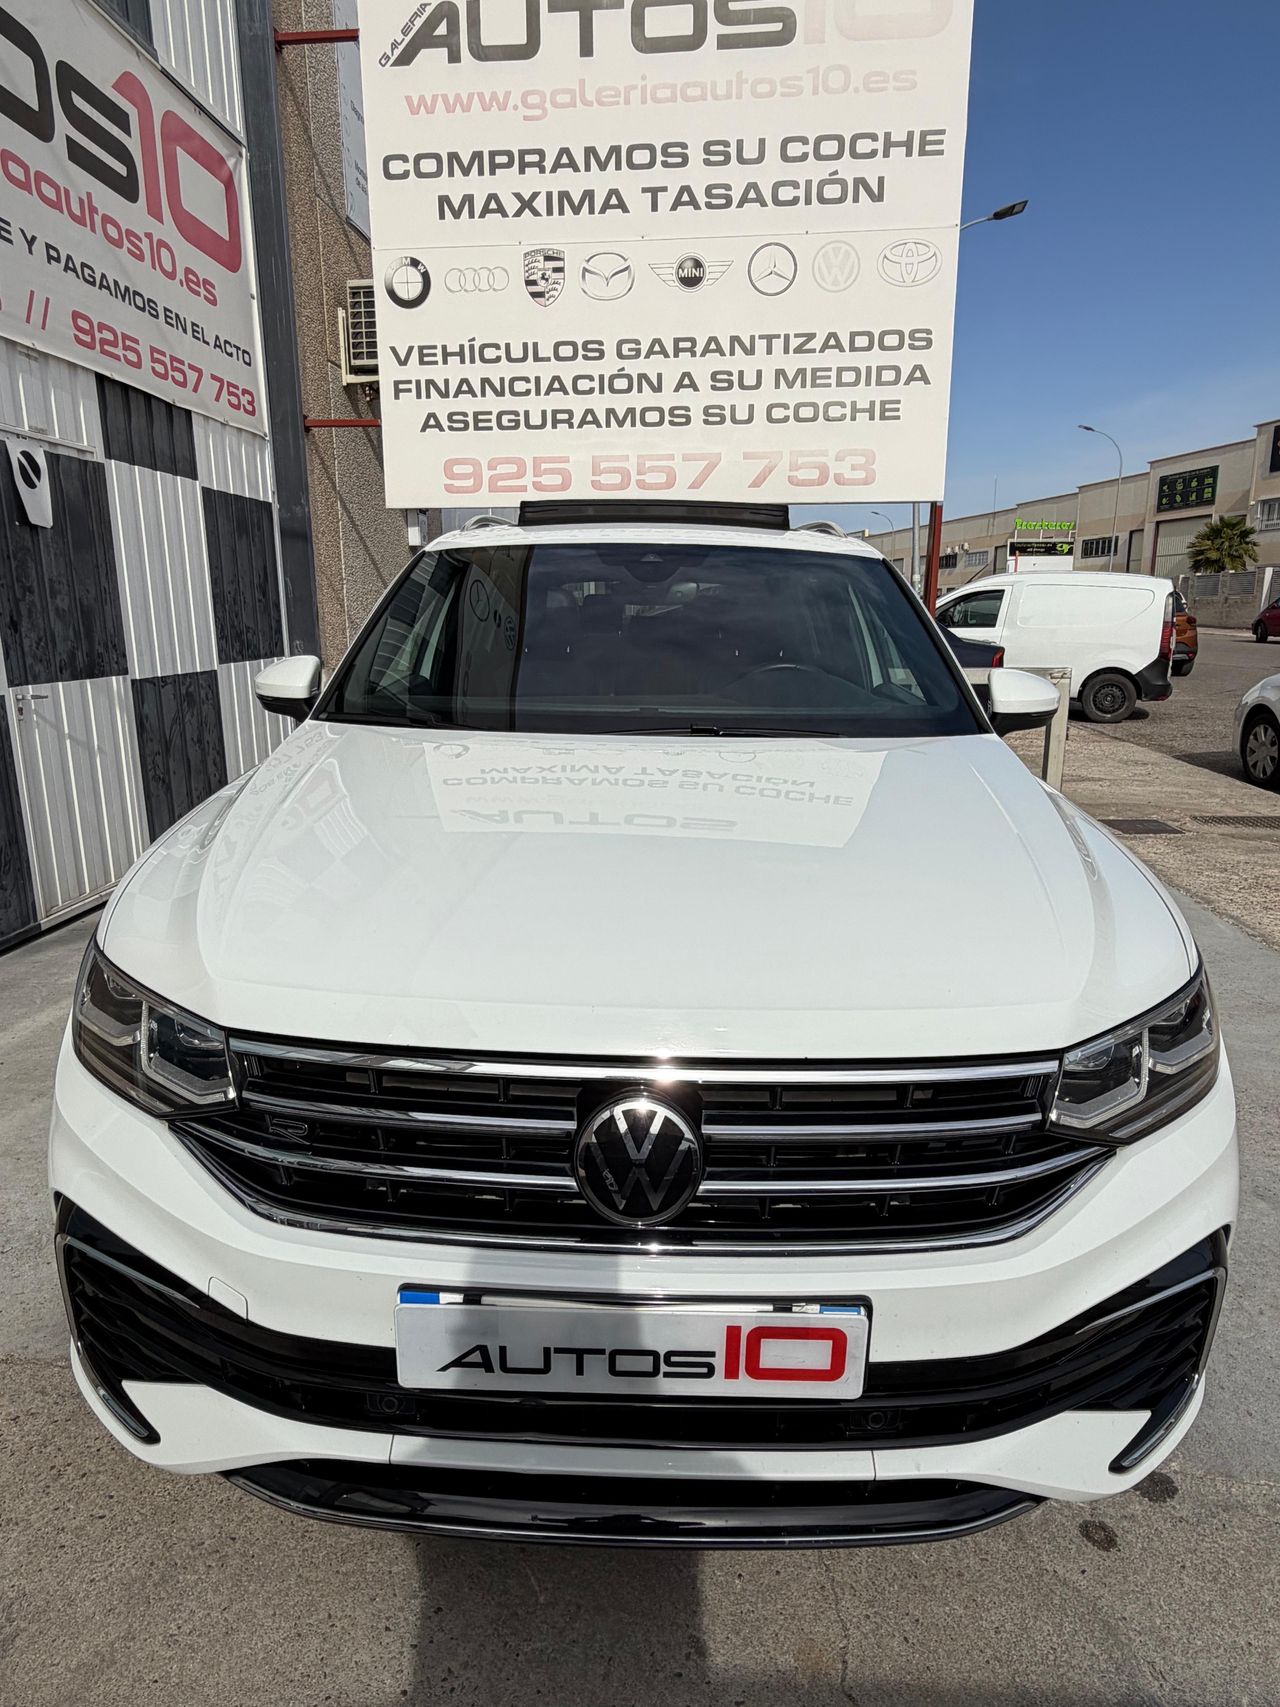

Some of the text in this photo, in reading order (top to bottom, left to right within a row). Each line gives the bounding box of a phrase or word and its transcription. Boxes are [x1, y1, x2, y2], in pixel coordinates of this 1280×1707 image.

[379, 2, 432, 67] GALERIA
[404, 64, 917, 122] www.galeriaautos10.es
[383, 141, 689, 181] COMPRAMOS
[703, 138, 766, 166] SU
[779, 129, 947, 163] COCHE
[437, 169, 886, 220] MAXIMA TASACIÓN
[19, 227, 38, 256] Y
[45, 241, 160, 320] PAGAMOS
[163, 305, 188, 336] EN
[191, 320, 211, 347] EL
[213, 334, 252, 368] ACTO
[678, 266, 704, 279] MINI
[70, 310, 143, 370] 925
[148, 345, 205, 394] 557
[209, 372, 257, 417] 753
[389, 328, 934, 367] VEHÍCULOS GARANTIZADOS
[393, 363, 932, 401] FINANCIACIÓN A SU MEDIDA
[420, 399, 902, 433] ASEGURAMOS SU COCHE
[442, 448, 877, 496] 925 557 753
[436, 1325, 848, 1382] AUTOS10
